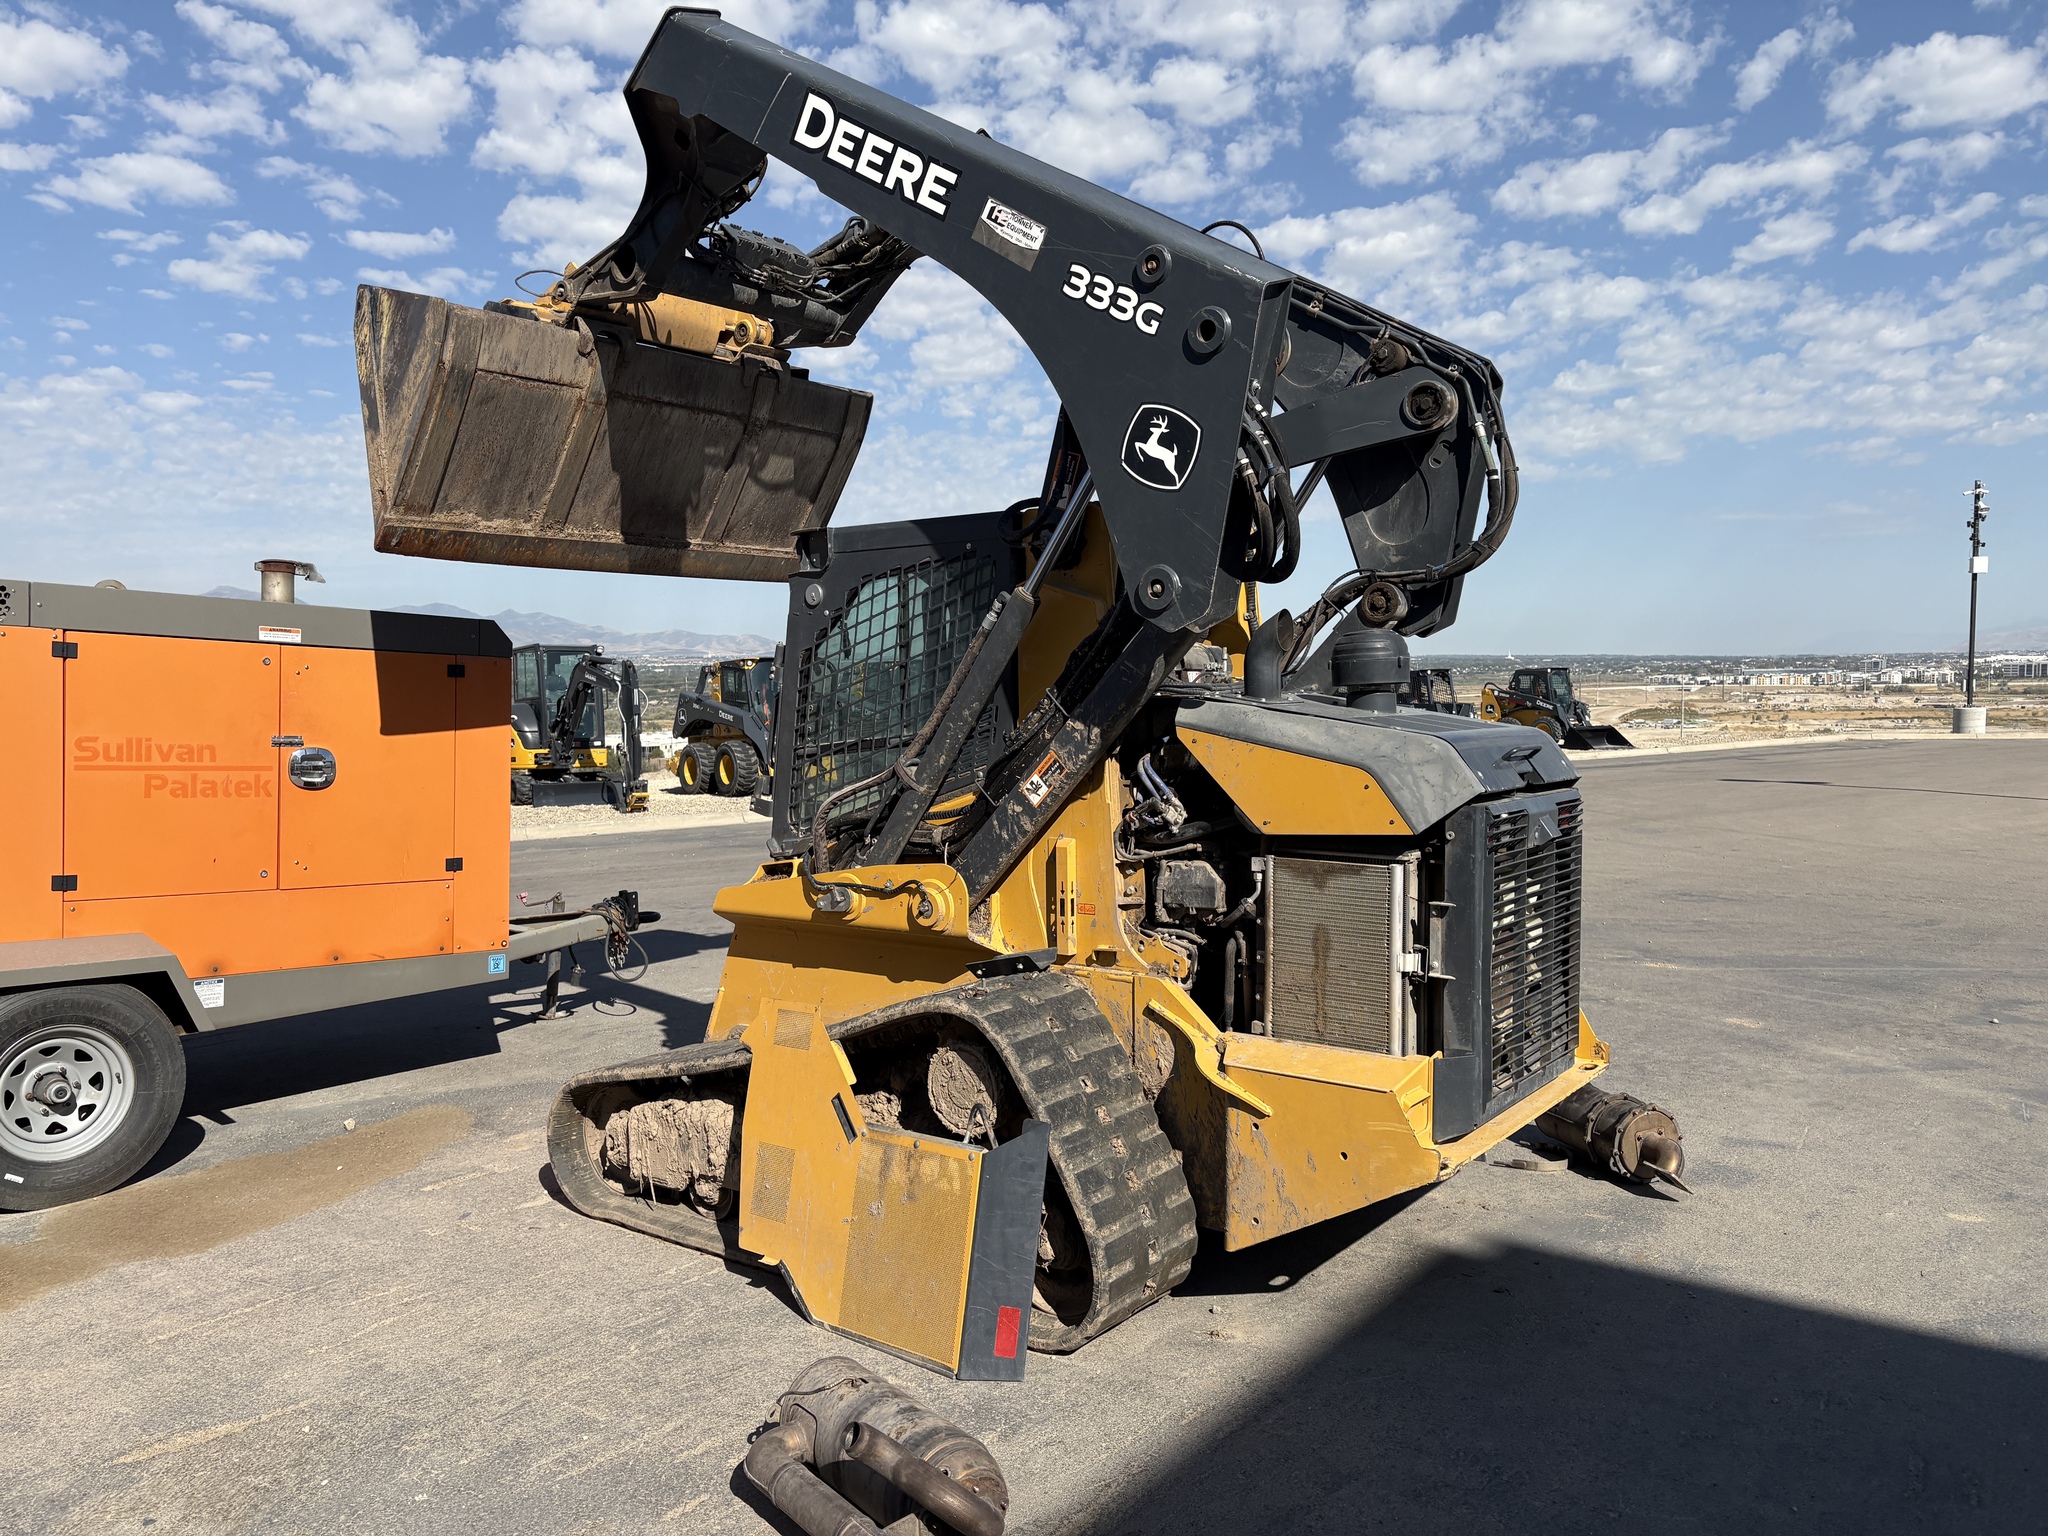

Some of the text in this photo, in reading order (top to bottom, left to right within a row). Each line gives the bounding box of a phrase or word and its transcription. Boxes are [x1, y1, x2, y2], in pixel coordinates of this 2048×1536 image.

[794, 92, 958, 216] DEERE
[1006, 222, 1038, 244] EQUIPMENT
[1062, 264, 1164, 335] 333G
[718, 710, 734, 722] DEERE
[1536, 699, 1554, 711] DEERE
[73, 736, 217, 763] Sullivan
[143, 773, 273, 799] Palatek
